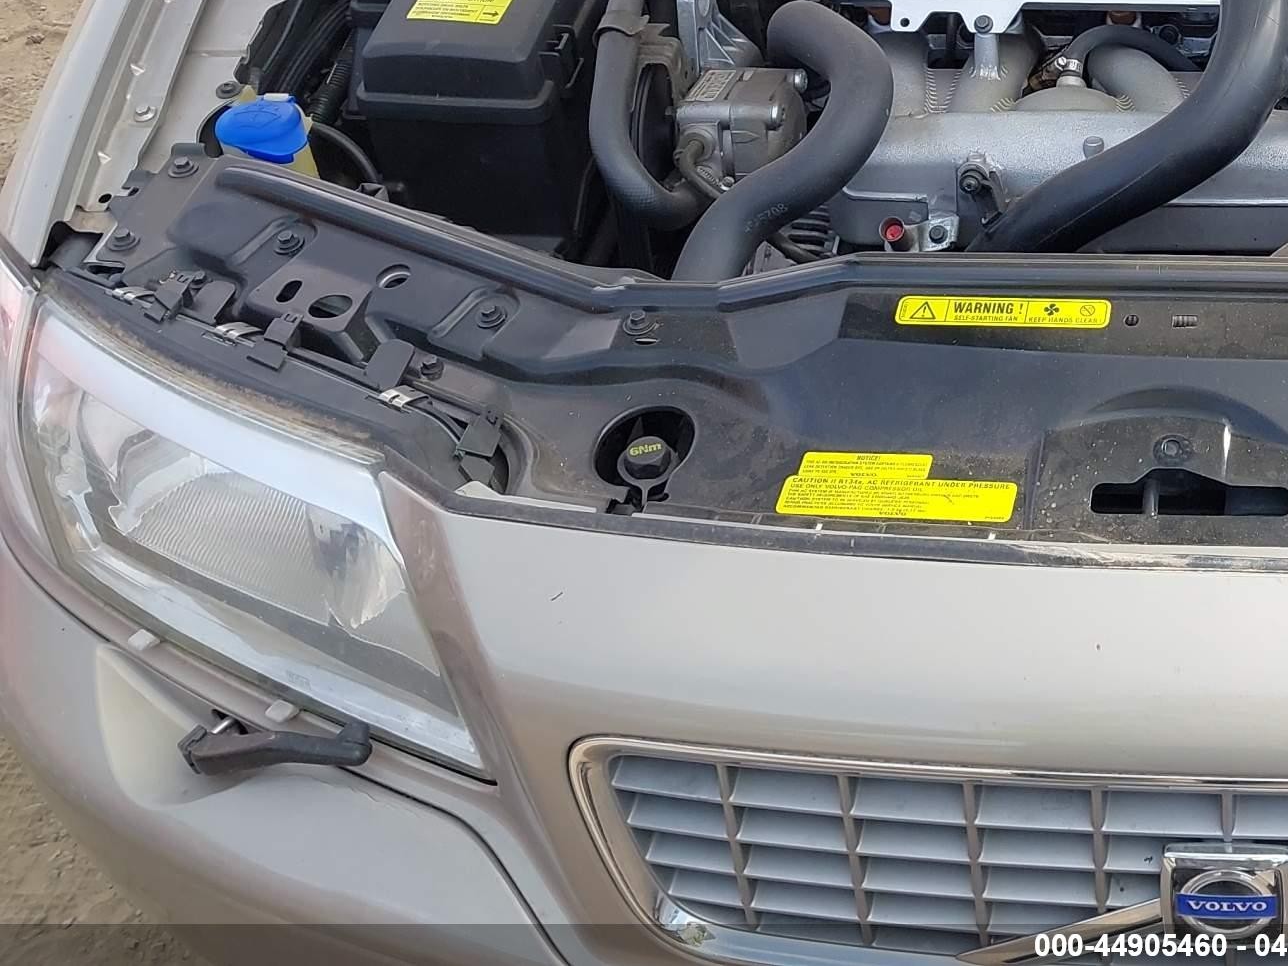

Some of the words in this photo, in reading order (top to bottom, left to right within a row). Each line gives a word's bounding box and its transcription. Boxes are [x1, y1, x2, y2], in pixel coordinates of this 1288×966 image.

[953, 301, 1015, 315] WARNING
[1017, 303, 1025, 315] !
[953, 314, 1003, 322] SELF-STARTING
[629, 443, 662, 456] 6Nm
[1186, 900, 1268, 912] VOLVO
